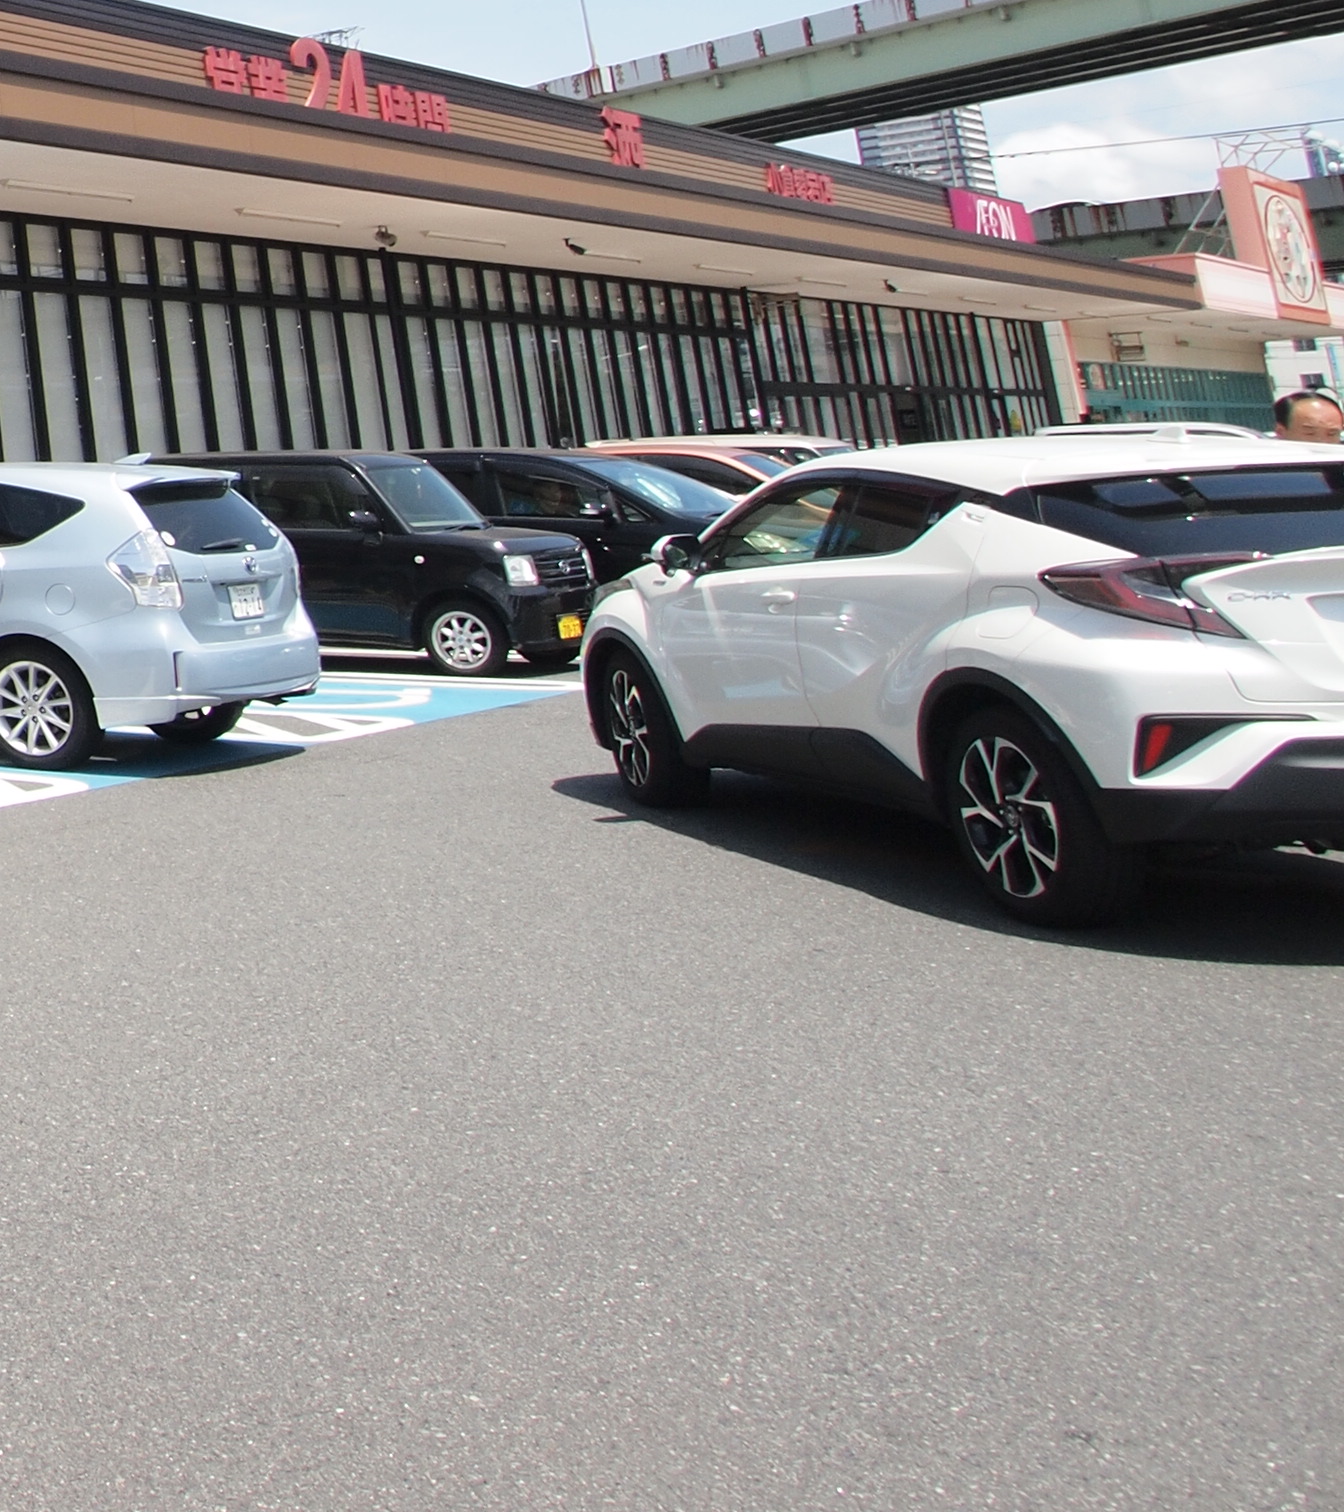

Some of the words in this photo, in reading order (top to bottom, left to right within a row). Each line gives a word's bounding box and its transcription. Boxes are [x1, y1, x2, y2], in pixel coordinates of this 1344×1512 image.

[203, 37, 452, 133] 営業24時間
[600, 106, 645, 169] 酒
